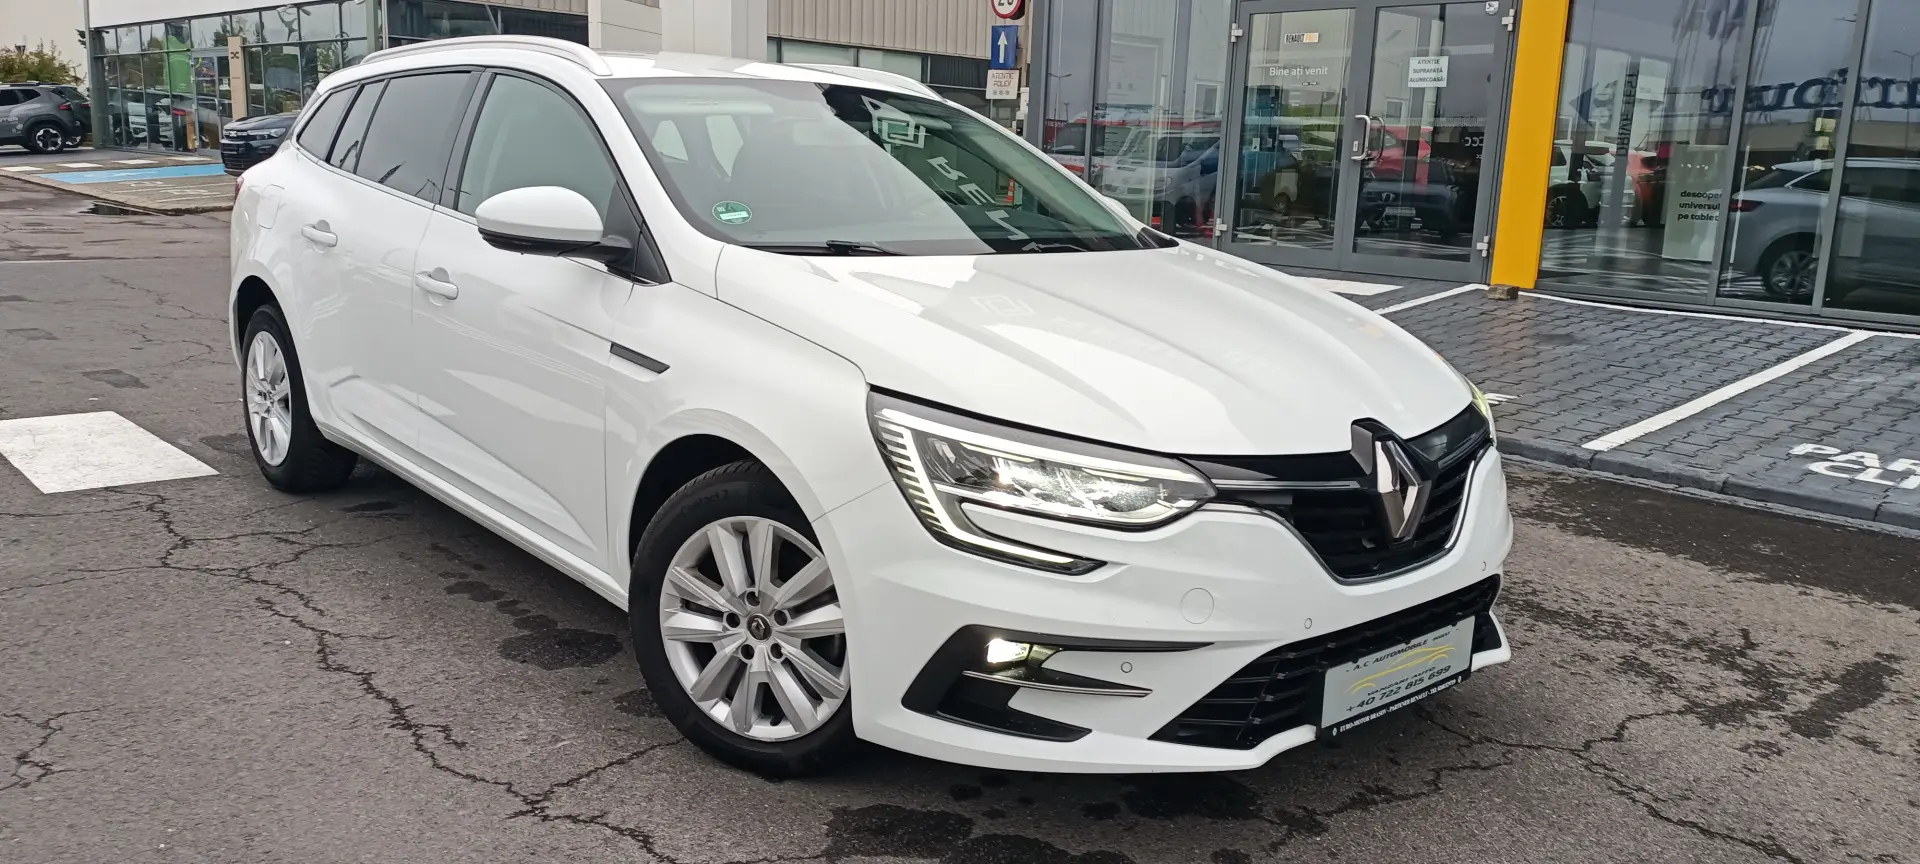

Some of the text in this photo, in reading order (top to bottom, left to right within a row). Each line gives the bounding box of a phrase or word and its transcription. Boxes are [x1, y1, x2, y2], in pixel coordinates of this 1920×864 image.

[1269, 67, 1290, 76] Bine
[1304, 65, 1329, 76] venit
[1677, 213, 1689, 222] pe
[1372, 639, 1428, 665] AUTOMOBILE
[1345, 696, 1376, 712] +40
[1379, 686, 1402, 700] 722
[1405, 676, 1425, 690] 815
[1428, 664, 1451, 680] 699
